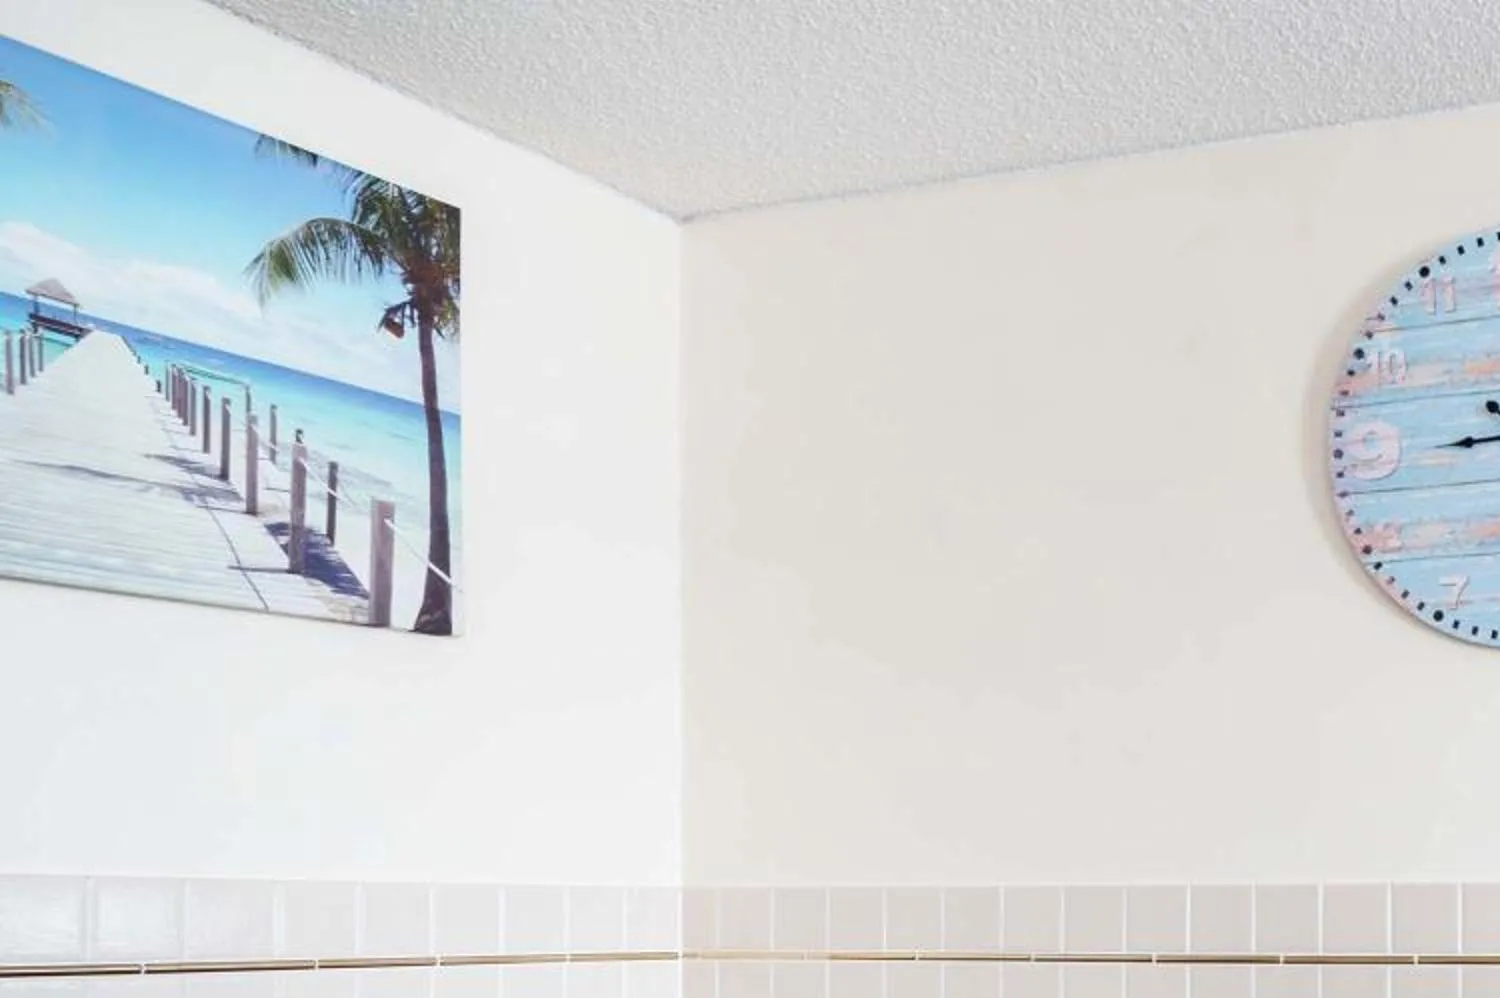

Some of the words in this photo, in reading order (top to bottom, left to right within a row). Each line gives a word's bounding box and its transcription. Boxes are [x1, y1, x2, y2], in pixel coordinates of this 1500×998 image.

[1420, 276, 1457, 315] 11
[1343, 421, 1401, 481] 9
[1439, 573, 1470, 610] 7
